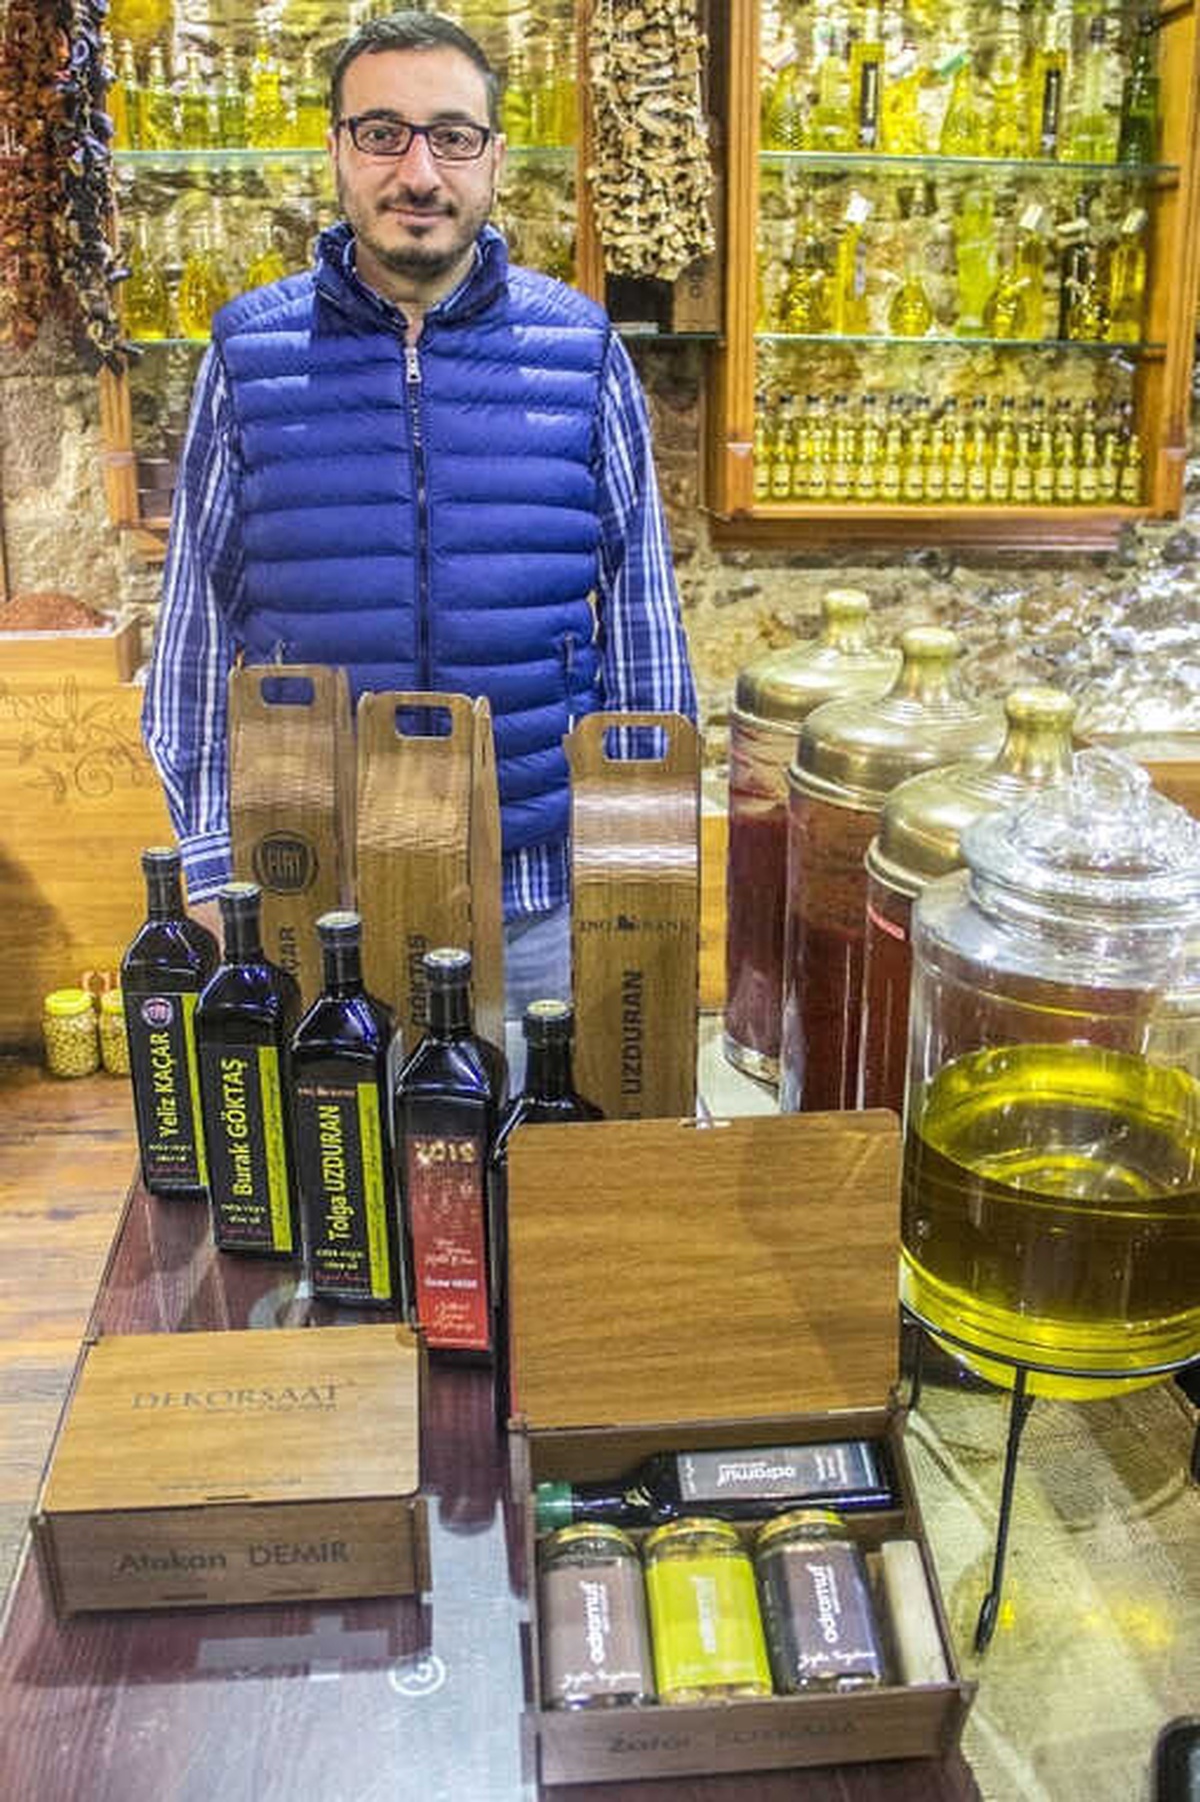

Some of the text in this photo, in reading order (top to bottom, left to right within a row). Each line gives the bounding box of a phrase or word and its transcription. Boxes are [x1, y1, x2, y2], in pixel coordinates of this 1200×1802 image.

[149, 1031, 177, 1093] KAÇAR
[621, 970, 641, 1094] UZDURAN
[157, 1096, 179, 1138] Yeliz
[220, 1058, 249, 1138] GÖKTAŞ
[228, 1141, 253, 1196] Burak
[317, 1105, 346, 1191] UZDURAN
[324, 1195, 355, 1241] Tolga
